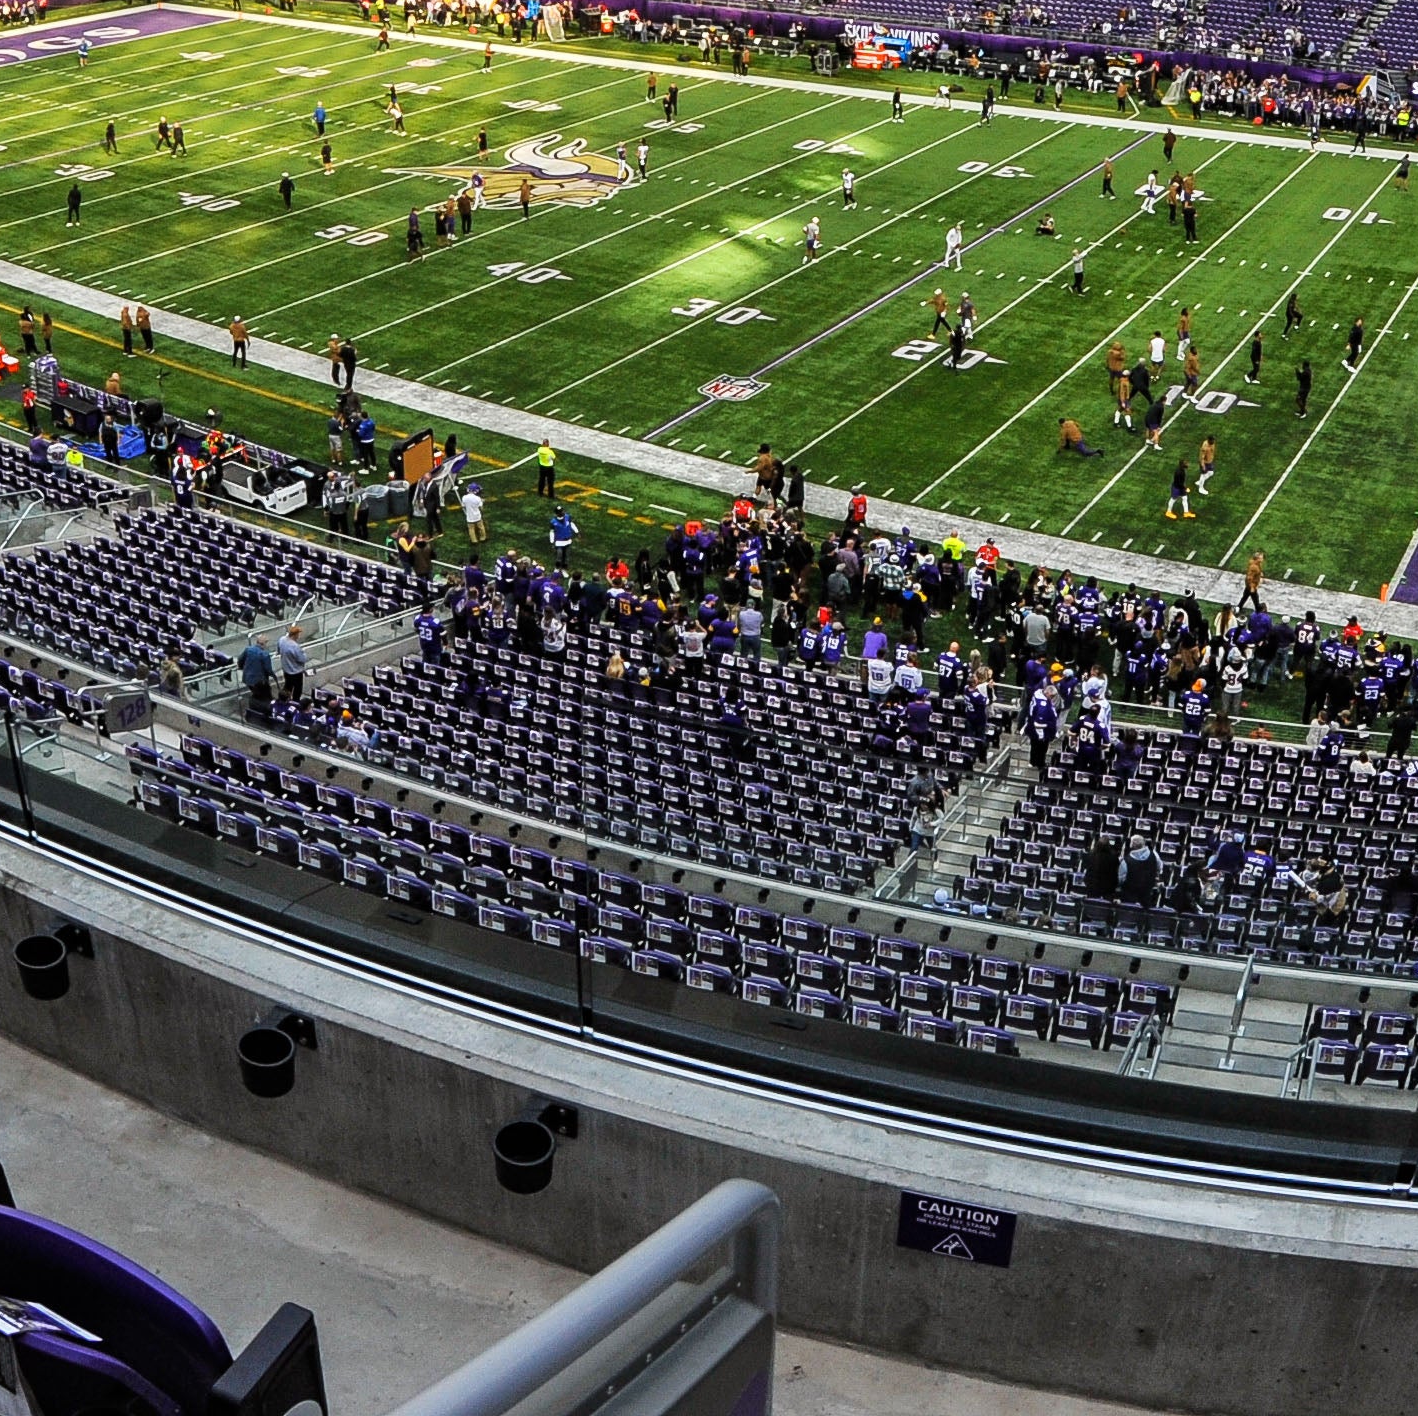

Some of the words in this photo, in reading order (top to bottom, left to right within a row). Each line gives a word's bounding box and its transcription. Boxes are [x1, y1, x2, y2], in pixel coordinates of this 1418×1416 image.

[890, 29, 941, 48] VIKINGS
[54, 163, 115, 182] 30
[957, 160, 1024, 178] 30
[178, 191, 241, 212] 40
[1322, 206, 1379, 225] 10
[314, 224, 389, 247] 50
[486, 261, 562, 283] 40
[670, 297, 763, 326] 30
[891, 339, 988, 371] 20
[706, 380, 749, 399] NFL
[1298, 631, 1314, 644] 84
[939, 665, 952, 678] 87
[1364, 689, 1378, 700] 23
[117, 698, 147, 725] 128
[1185, 702, 1202, 715] 22
[1080, 727, 1095, 744] 84
[918, 1198, 1000, 1226] CAUTION
